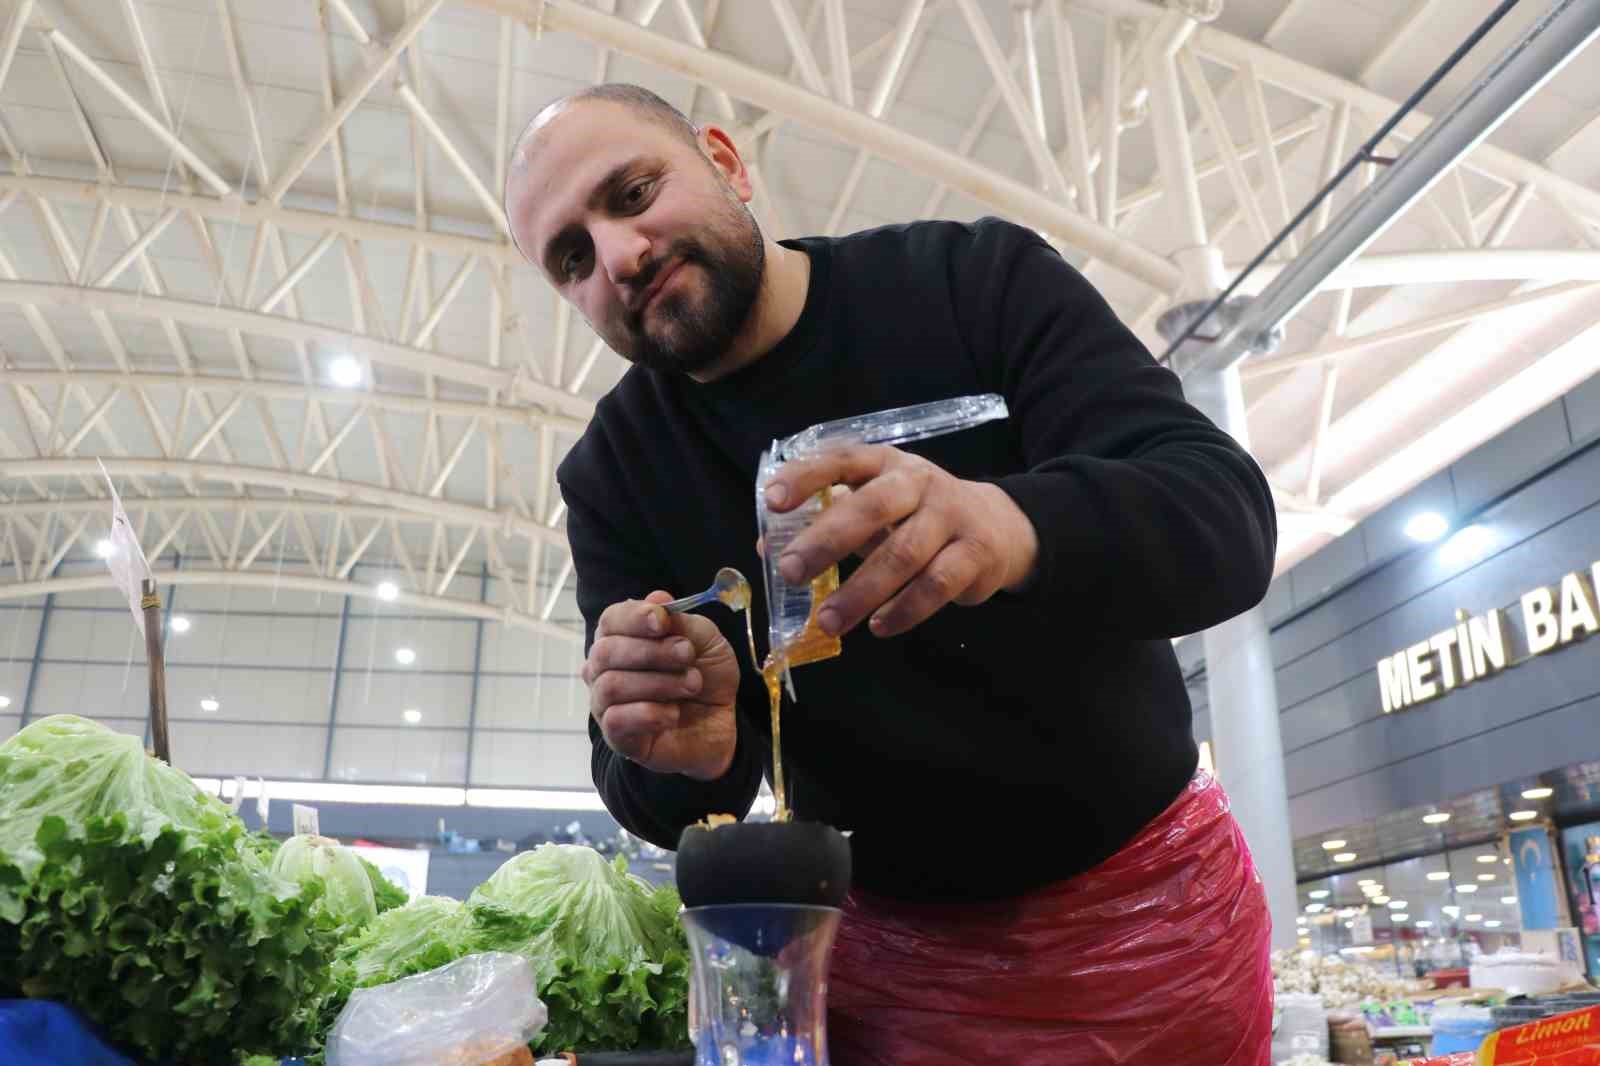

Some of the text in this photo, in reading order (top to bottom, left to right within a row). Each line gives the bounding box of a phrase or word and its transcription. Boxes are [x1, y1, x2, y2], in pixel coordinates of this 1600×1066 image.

[1377, 560, 1600, 713] METİN BA
[1515, 1012, 1591, 1045] Limon
